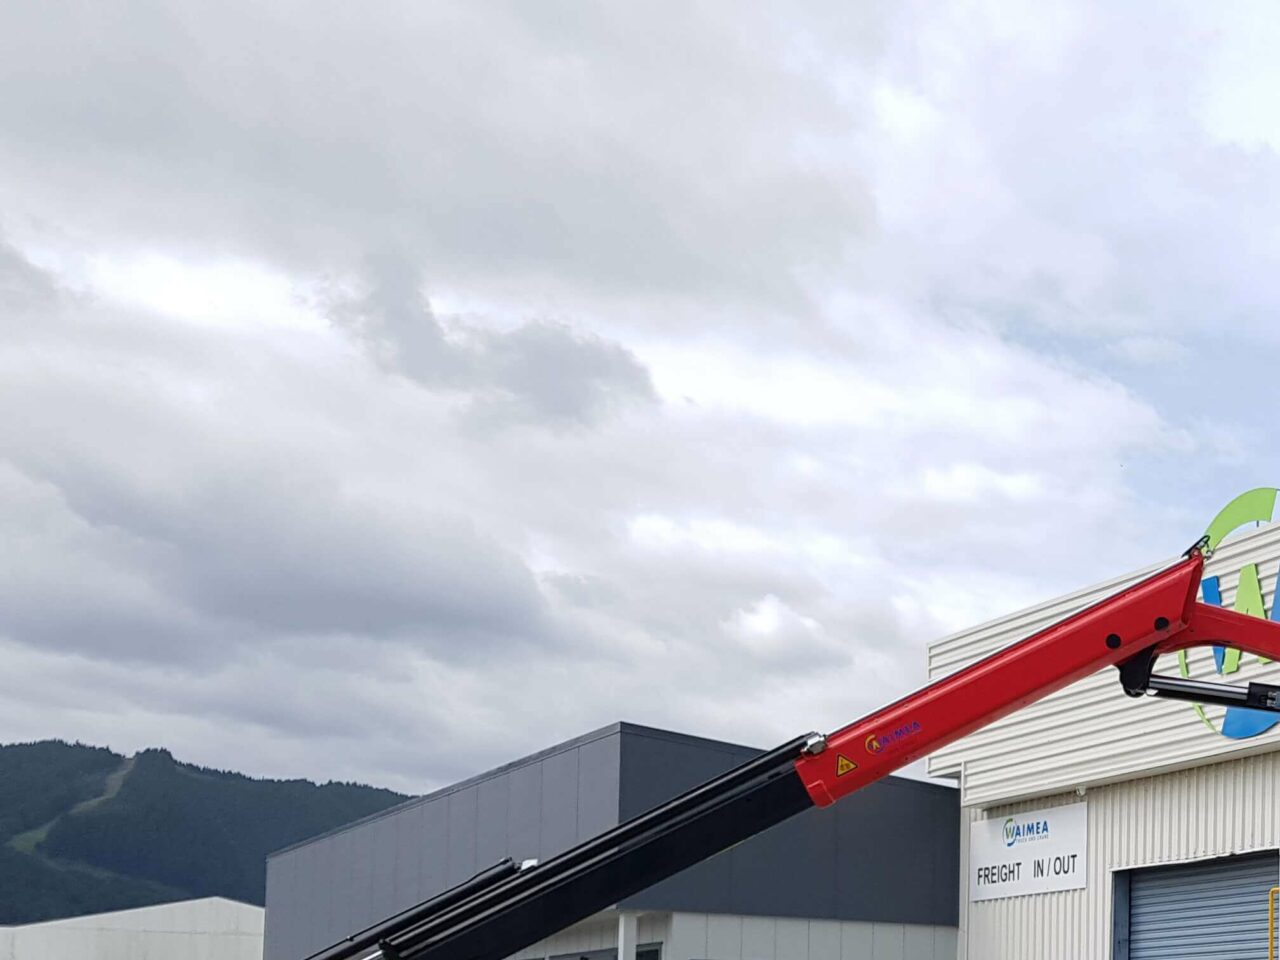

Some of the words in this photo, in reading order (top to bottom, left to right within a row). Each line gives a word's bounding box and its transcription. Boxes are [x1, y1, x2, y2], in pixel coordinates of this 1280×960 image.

[1004, 820, 1049, 841] WAIMEA
[977, 862, 1022, 886] FREIGHT
[1033, 858, 1045, 878] IN
[1053, 854, 1077, 876] OUT
